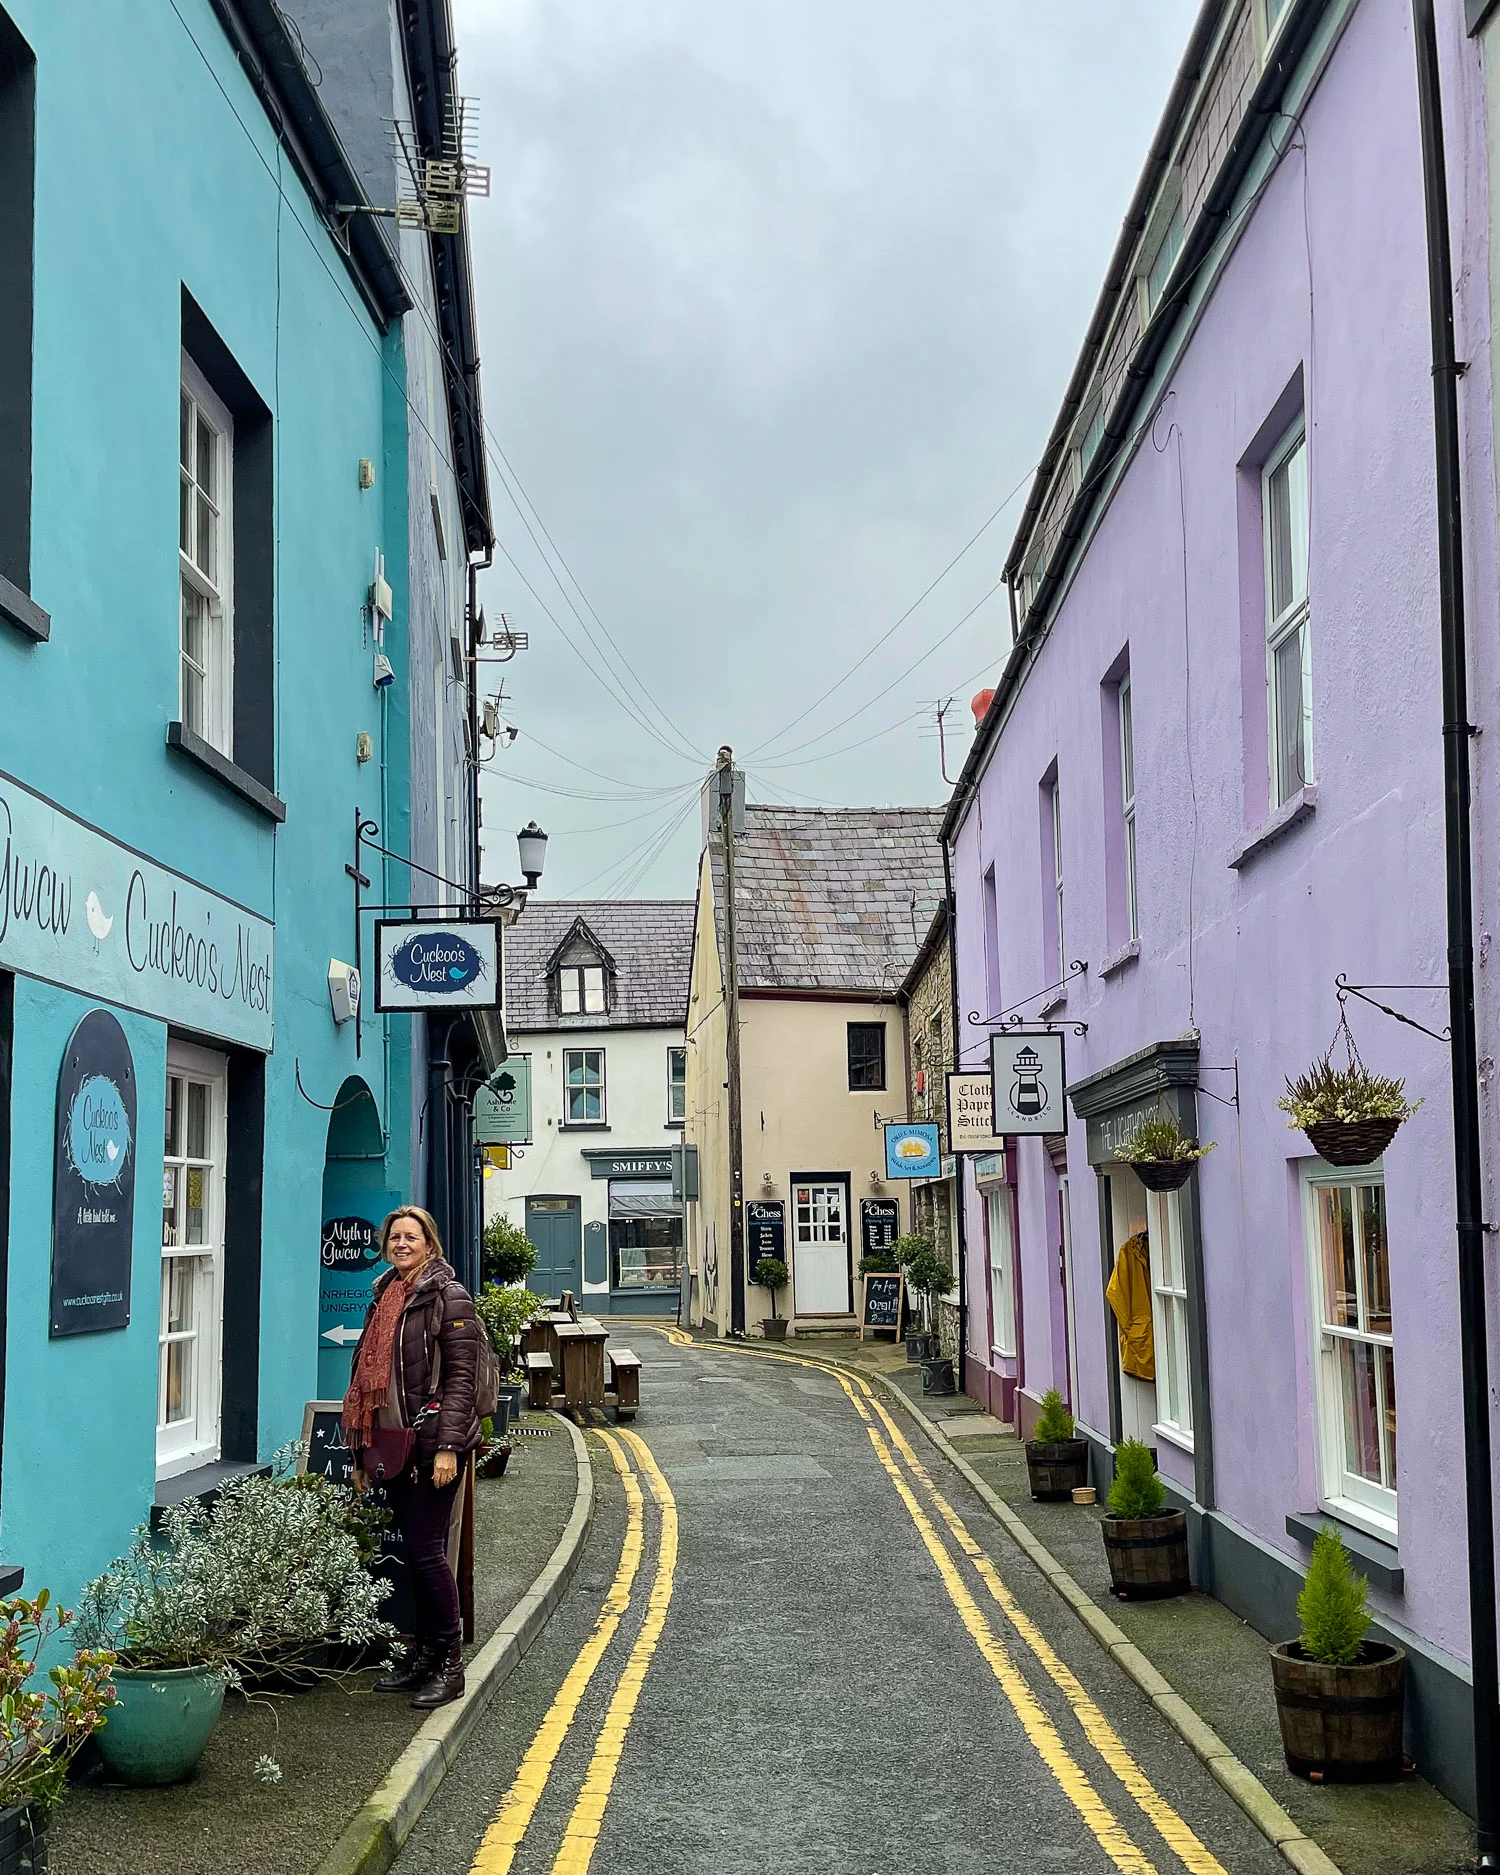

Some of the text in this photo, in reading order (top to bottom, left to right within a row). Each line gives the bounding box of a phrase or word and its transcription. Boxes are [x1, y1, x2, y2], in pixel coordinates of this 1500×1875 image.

[125, 868, 219, 994] Cuckoo's
[220, 922, 271, 1014] Nest
[410, 943, 466, 965] Cuckoo's
[409, 962, 447, 983] Nest
[82, 1094, 119, 1131] Cuckoo's
[493, 1105, 500, 1113] &
[956, 1098, 992, 1113] Pape
[1006, 1105, 1052, 1122] LLANDEILO
[1100, 1121, 1112, 1151] THE
[81, 1130, 107, 1164] Nest
[612, 1160, 673, 1172] SMIFFY'S
[755, 1208, 782, 1218] Chess
[869, 1205, 895, 1216] Chess
[322, 1222, 372, 1246] Nyth y
[322, 1241, 361, 1266] Gwcw
